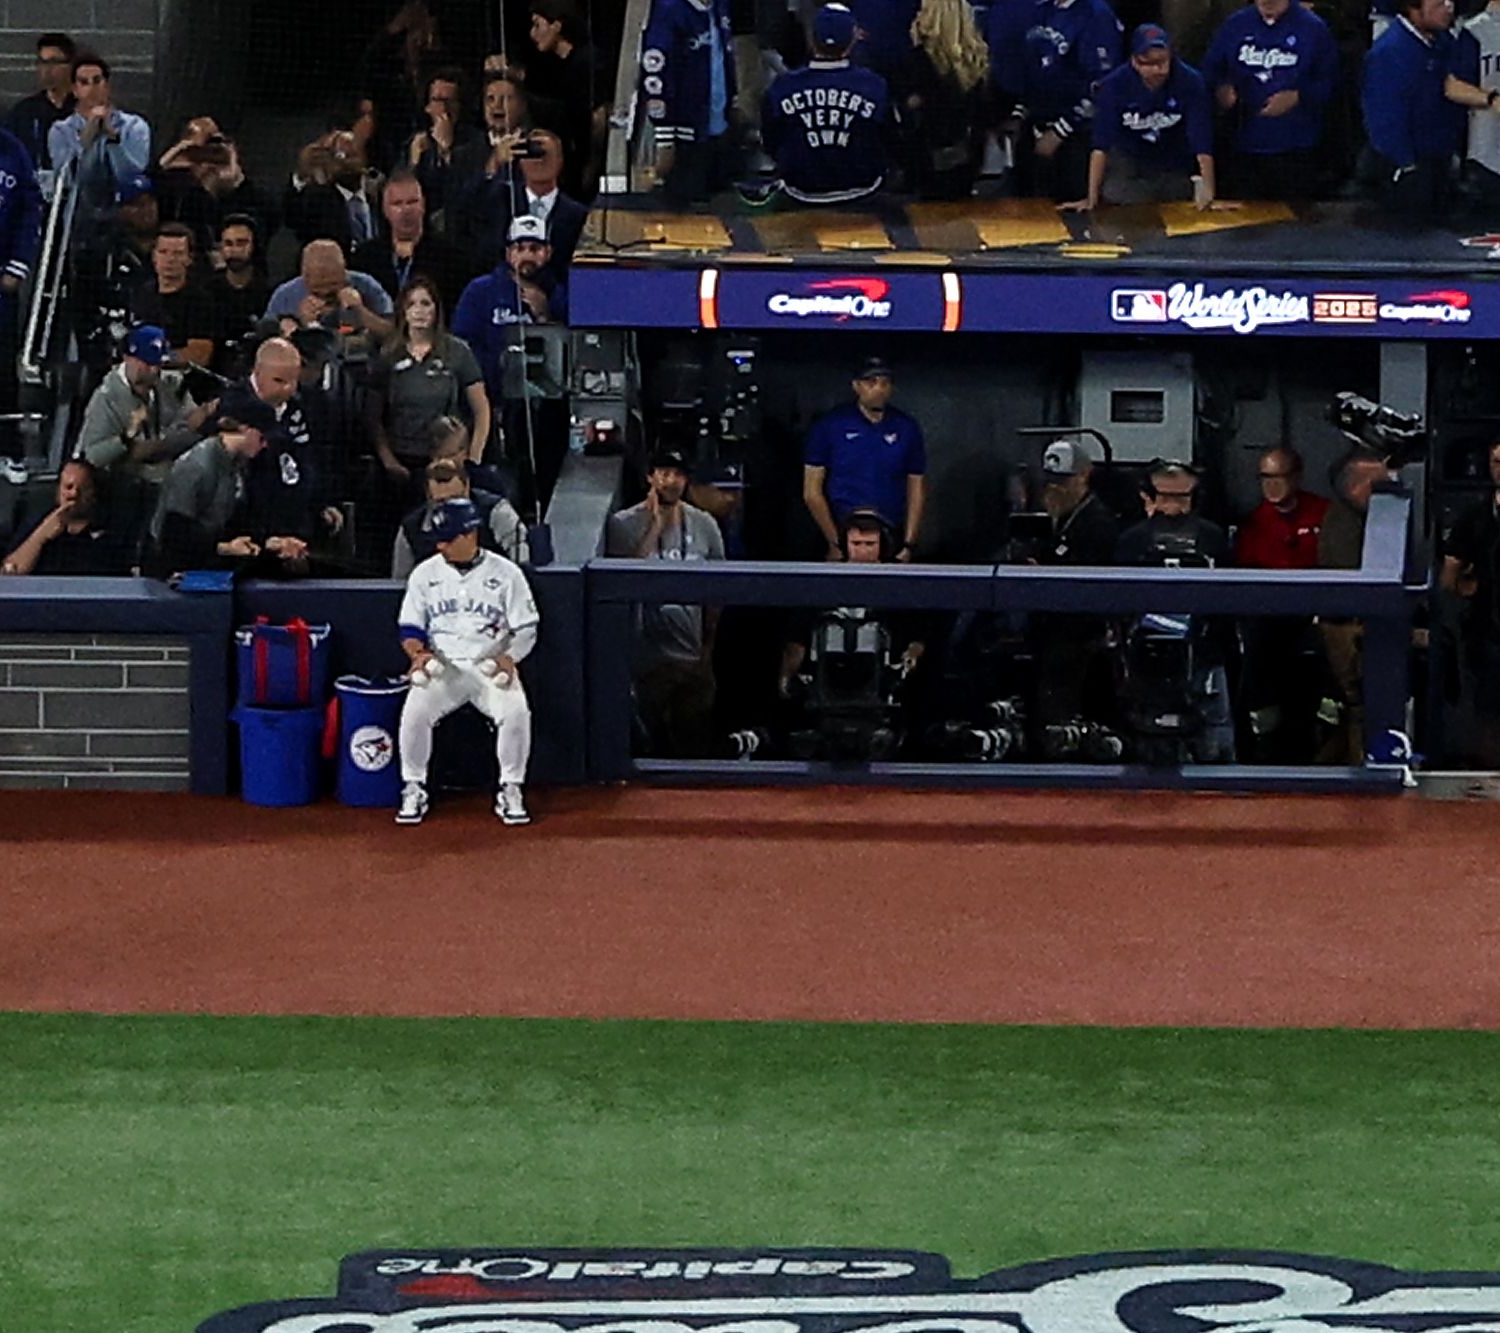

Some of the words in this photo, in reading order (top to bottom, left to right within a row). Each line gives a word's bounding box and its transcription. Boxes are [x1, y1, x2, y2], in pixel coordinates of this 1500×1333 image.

[781, 88, 876, 118] OCTOBER'S
[800, 109, 854, 128] VERY
[806, 131, 850, 148] OWN
